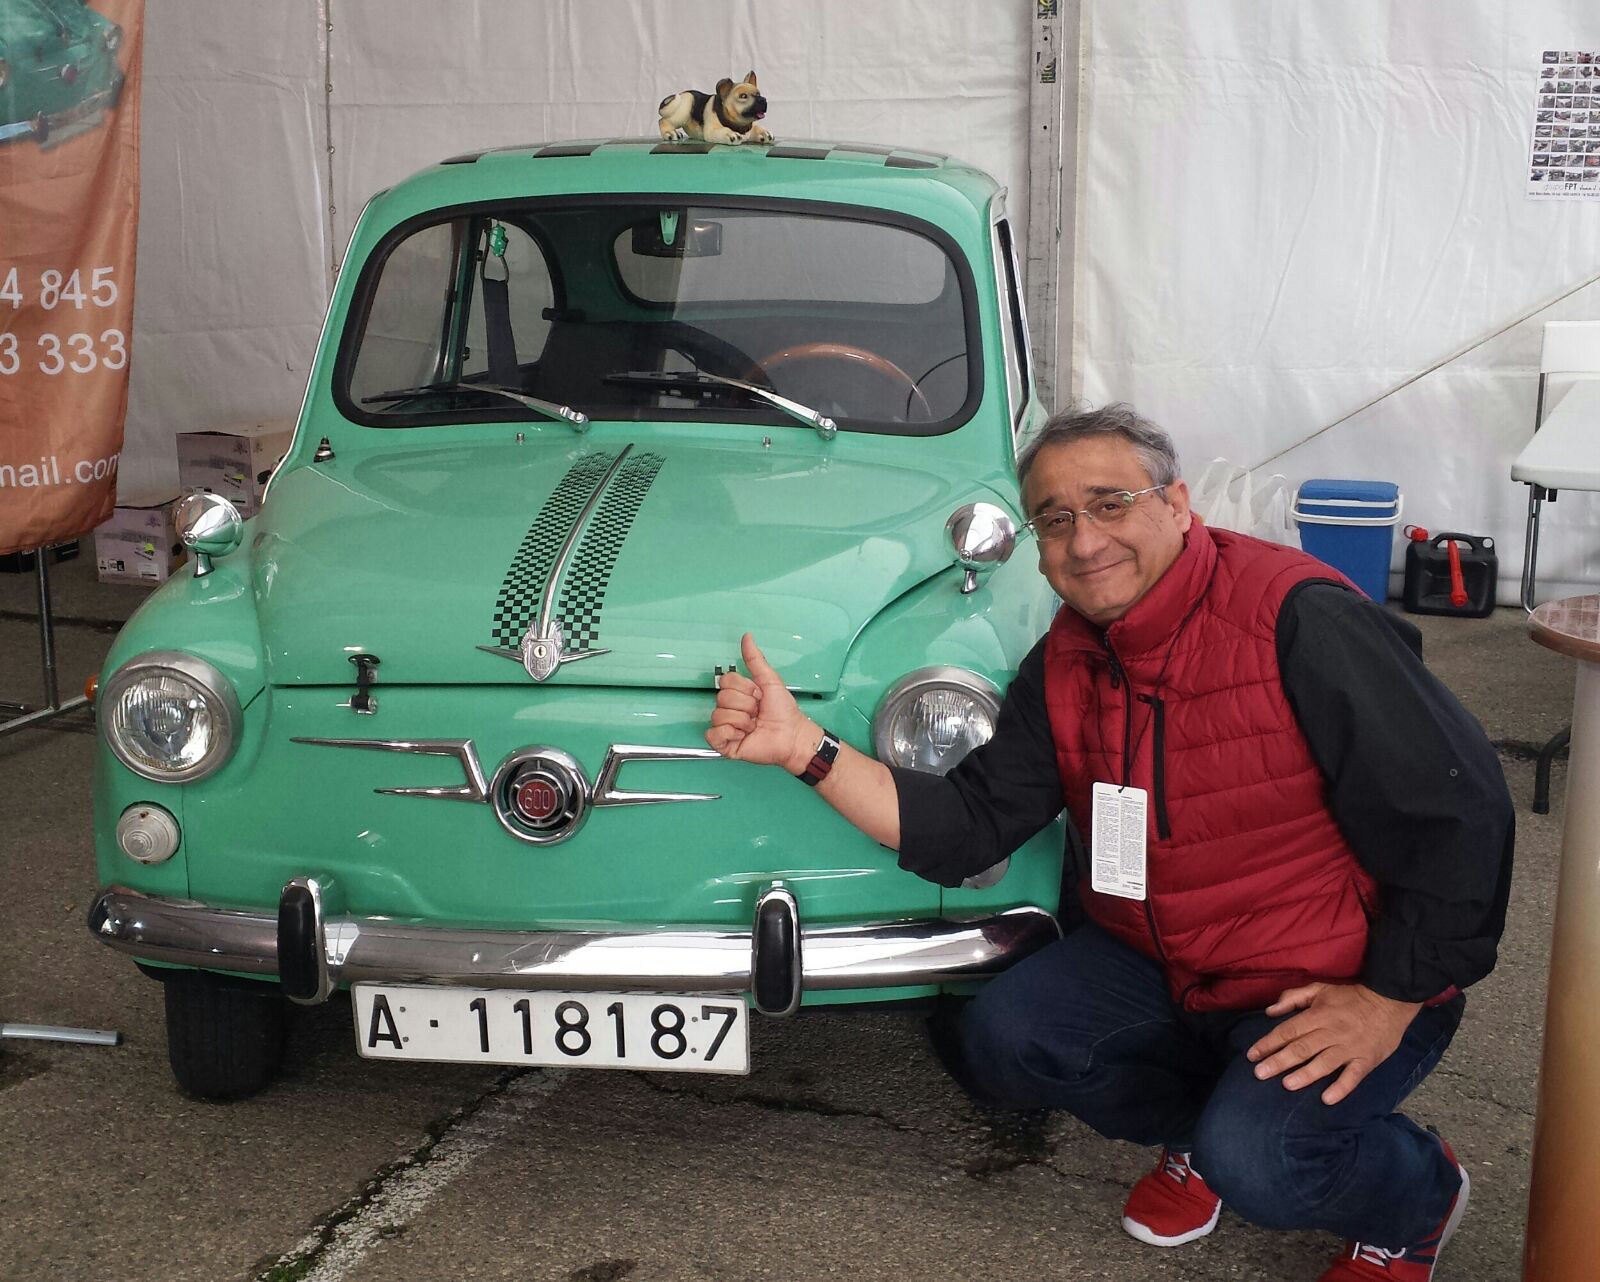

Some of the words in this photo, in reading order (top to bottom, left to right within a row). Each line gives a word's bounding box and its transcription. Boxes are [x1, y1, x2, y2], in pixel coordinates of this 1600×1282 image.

[40, 266, 118, 310] 845
[37, 328, 126, 375] 333
[524, 788, 551, 810] 600
